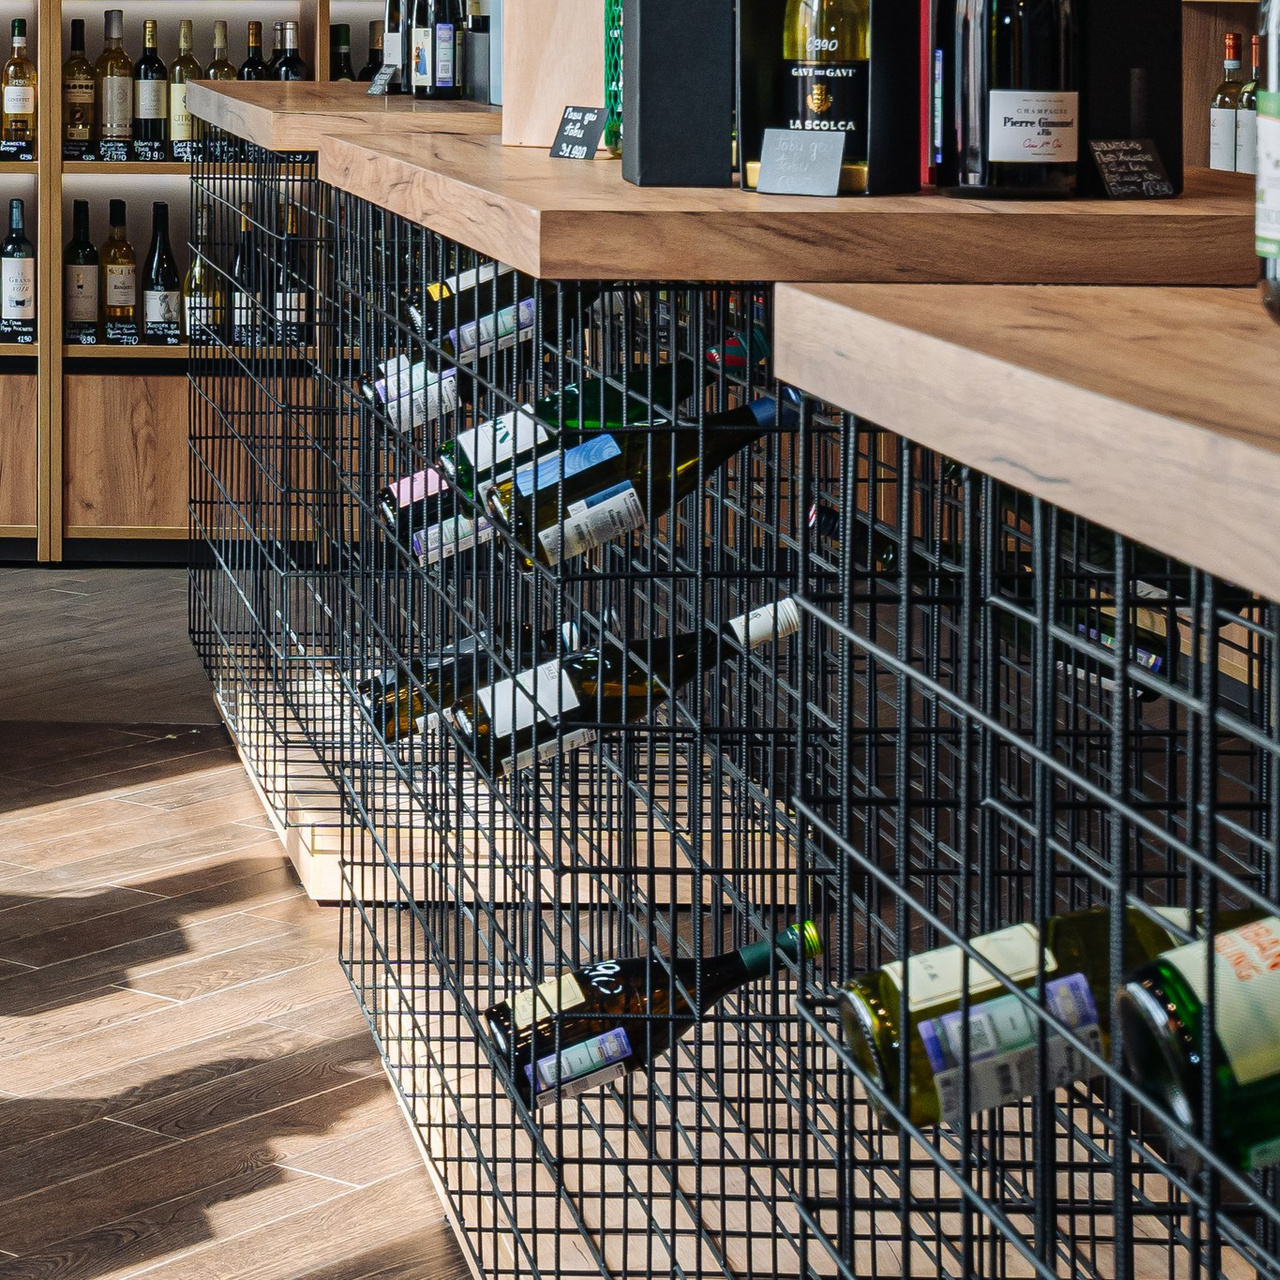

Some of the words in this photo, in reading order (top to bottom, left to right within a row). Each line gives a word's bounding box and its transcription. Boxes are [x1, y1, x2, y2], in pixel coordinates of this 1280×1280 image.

[806, 36, 839, 51] 6990
[792, 68, 813, 77] GAVI
[789, 120, 802, 129] LA
[805, 120, 855, 131] SCOLCA
[1004, 116, 1035, 128] Pierre
[140, 152, 165, 160] 2990
[81, 335, 96, 345] 890
